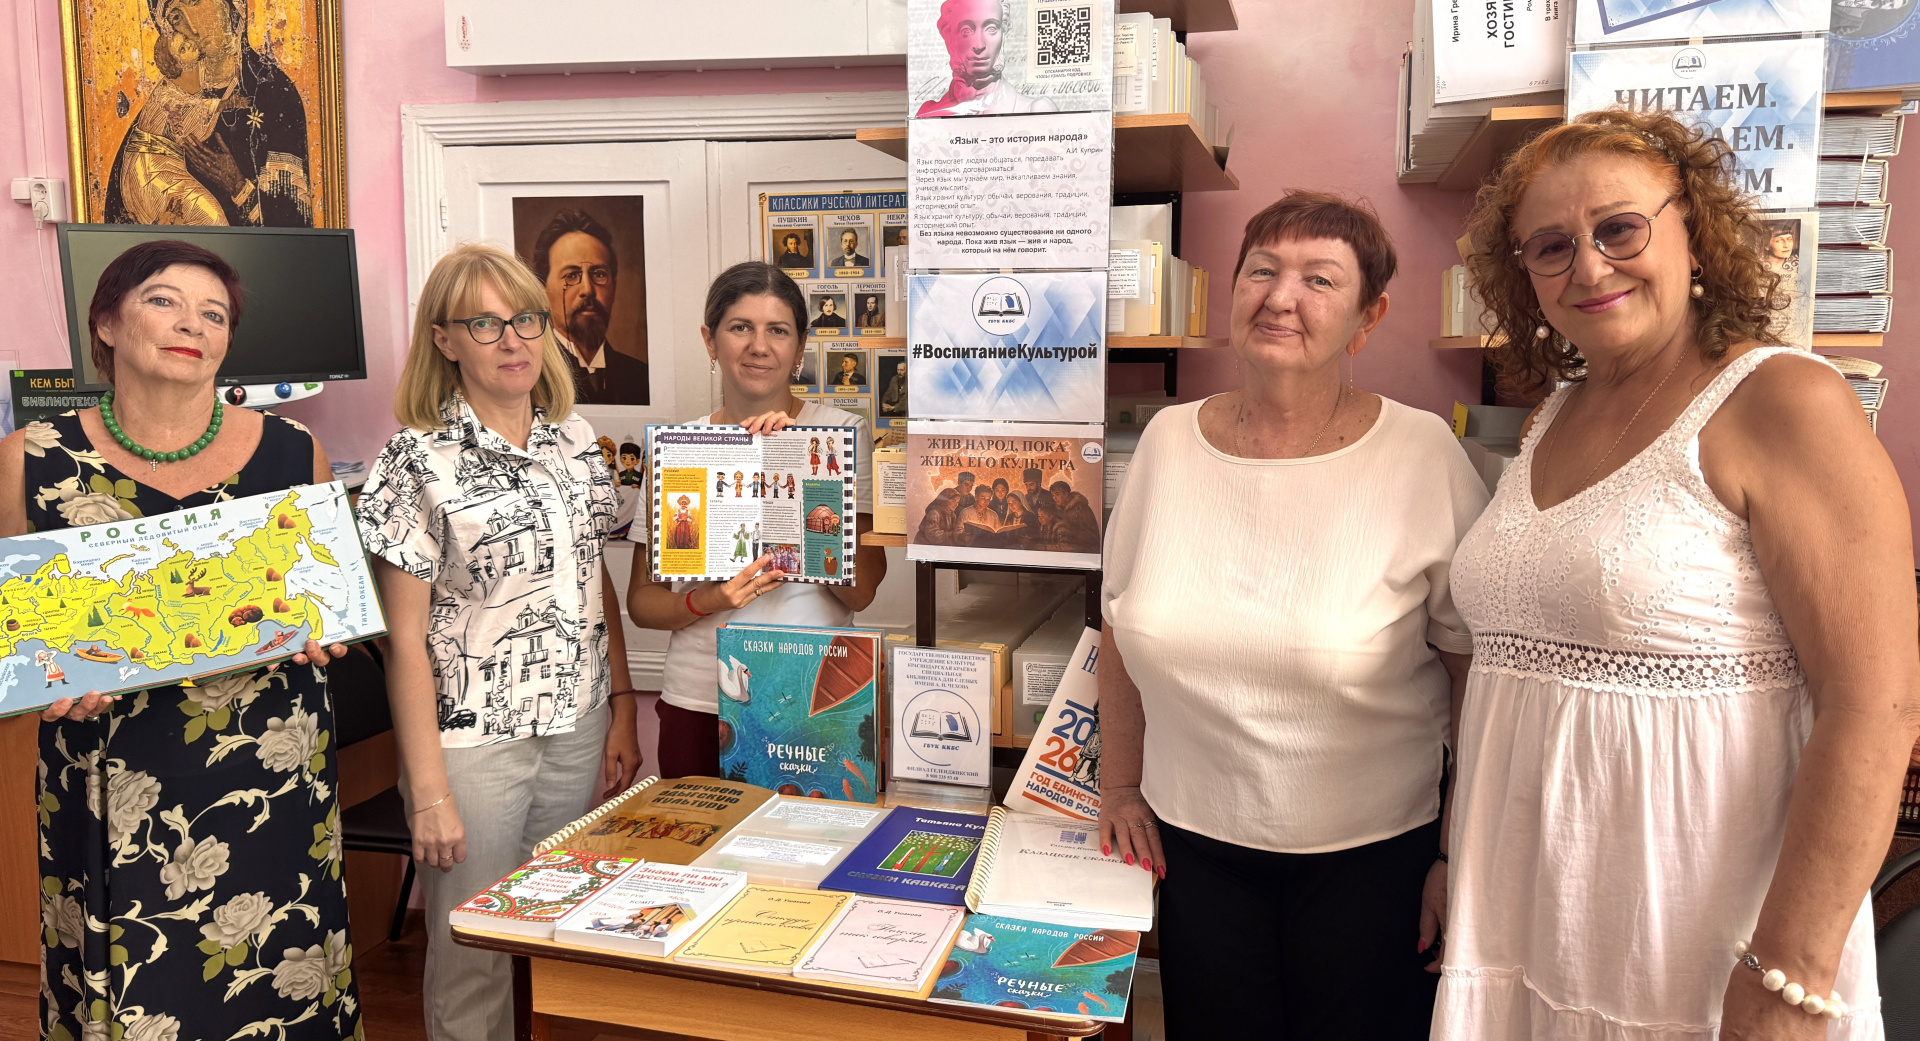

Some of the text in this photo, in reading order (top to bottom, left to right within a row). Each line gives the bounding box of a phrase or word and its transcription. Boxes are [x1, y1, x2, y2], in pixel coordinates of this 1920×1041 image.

[1486, 0, 1497, 38] ХОЗЯ
[1503, 0, 1514, 48] ГОСТИ
[1452, 16, 1460, 42] Ирина
[1614, 83, 1776, 112] ЧИТАЕМ.
[950, 134, 1088, 145] «Язык это история народа»
[1025, 155, 1063, 163] передавать
[773, 198, 819, 210] КЛАССИКИ
[822, 197, 862, 209] РУССКОЙ
[933, 193, 955, 201] хранит
[915, 202, 958, 210] исторический
[932, 213, 953, 221] хранит
[1000, 229, 1053, 237] существование
[913, 343, 1097, 362] #ВоспитаниеКультурой
[30, 378, 51, 388] КЕМ
[22, 397, 99, 407] БИБЛИОТЕКА
[928, 439, 1065, 453] ЖИВ НАРОД, ПОКА
[921, 455, 962, 467] ЖИВА
[968, 456, 996, 468] ЕГО
[1000, 457, 1075, 471] КУЛЬТУРА
[80, 508, 221, 542] РОССИЯ
[89, 522, 218, 548] СЕВЕРНЫЙ ЛЕДОВИТЫЙ ОКЕАН
[359, 602, 367, 626] ТИХИЙ
[744, 640, 847, 658] СКАЗКИ НАРОДОВ РОССИИ
[899, 651, 949, 659] ГОСУДАРСТВЕННОЕ
[1052, 709, 1095, 746] 20
[768, 743, 826, 762] РЕЧНЫЕ
[1039, 737, 1083, 772] 26
[780, 762, 818, 774] сказки
[1030, 772, 1052, 785] ГОД
[1026, 781, 1074, 807] НАРОДОВ
[915, 817, 962, 827] Татьяна
[543, 872, 580, 880] Лучшие
[639, 867, 680, 877] Знаем
[631, 873, 685, 883] русский
[688, 879, 728, 888] язык?
[848, 871, 966, 891] СКАЗКИ КАВКАЗА
[519, 885, 570, 894] писателей
[996, 923, 1104, 942] СКАЗКИ НАРОДОВ РОССИИ
[997, 976, 1064, 992] РЕЧНЫЕ
[1007, 989, 1051, 998] сказки
